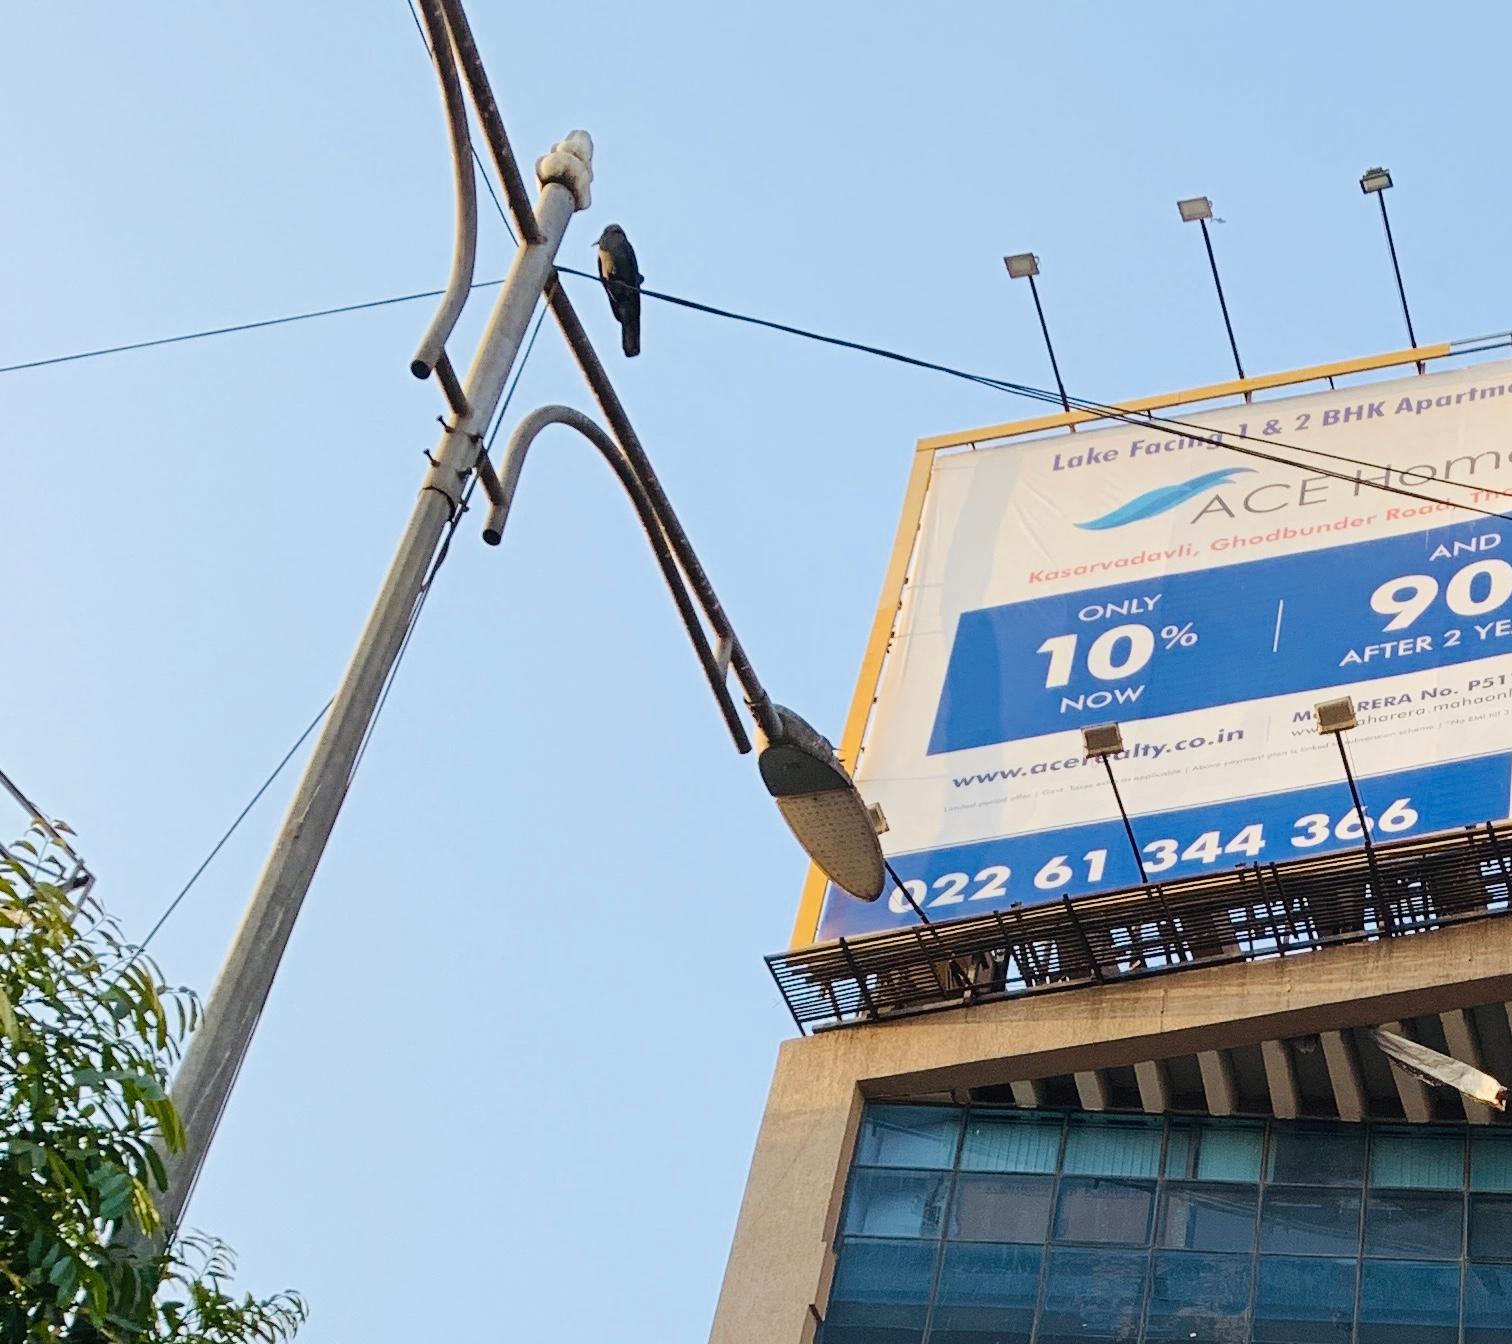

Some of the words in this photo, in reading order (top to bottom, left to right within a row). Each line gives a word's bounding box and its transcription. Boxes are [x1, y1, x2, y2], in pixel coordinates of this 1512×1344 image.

[1052, 446, 1119, 472] Lake
[1130, 429, 1224, 459] Facing
[1238, 424, 1249, 440] 1
[1262, 418, 1283, 437] &
[1295, 414, 1311, 431] 2
[1322, 401, 1385, 427] BHK
[1190, 477, 1329, 525] ACE
[1028, 541, 1202, 585] Kasarvadavli,
[1210, 511, 1377, 552] Ghodbunder
[1385, 498, 1458, 522] Road,
[1429, 533, 1502, 561] AND
[1078, 594, 1163, 622] ONLY
[1035, 622, 1199, 690] 10%
[1339, 635, 1433, 667] AFTER
[1443, 629, 1462, 648] 2
[1060, 685, 1146, 713] NOW
[1292, 693, 1412, 723] MRERA
[1420, 686, 1459, 701] No.
[887, 865, 1011, 914] 022
[1033, 849, 1107, 890] 61
[1141, 824, 1266, 874] 344
[1290, 798, 1419, 848] 366
